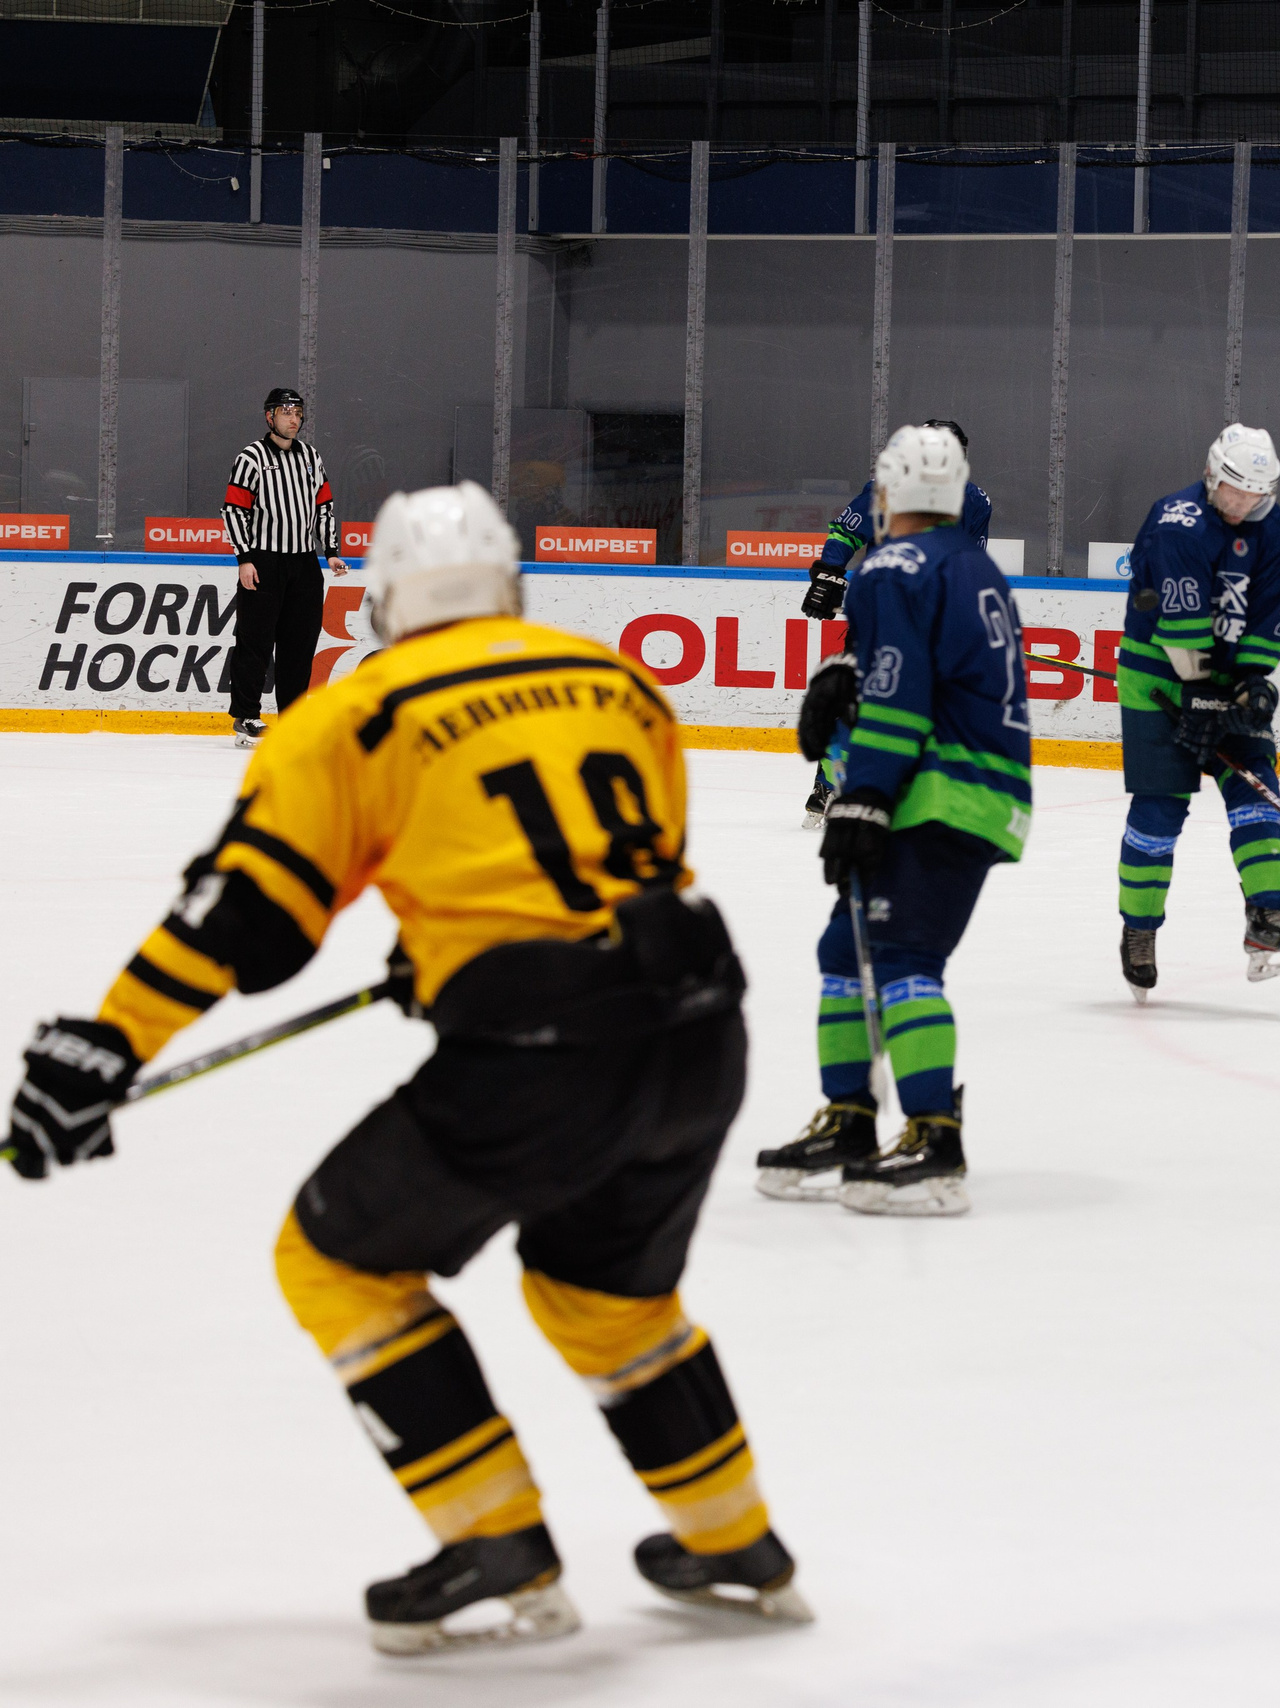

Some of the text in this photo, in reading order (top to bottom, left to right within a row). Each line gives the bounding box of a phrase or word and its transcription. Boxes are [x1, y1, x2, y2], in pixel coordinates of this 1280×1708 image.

[0, 525, 66, 539] PBET
[539, 537, 652, 554] OLIMPBET
[1162, 576, 1201, 613] 26
